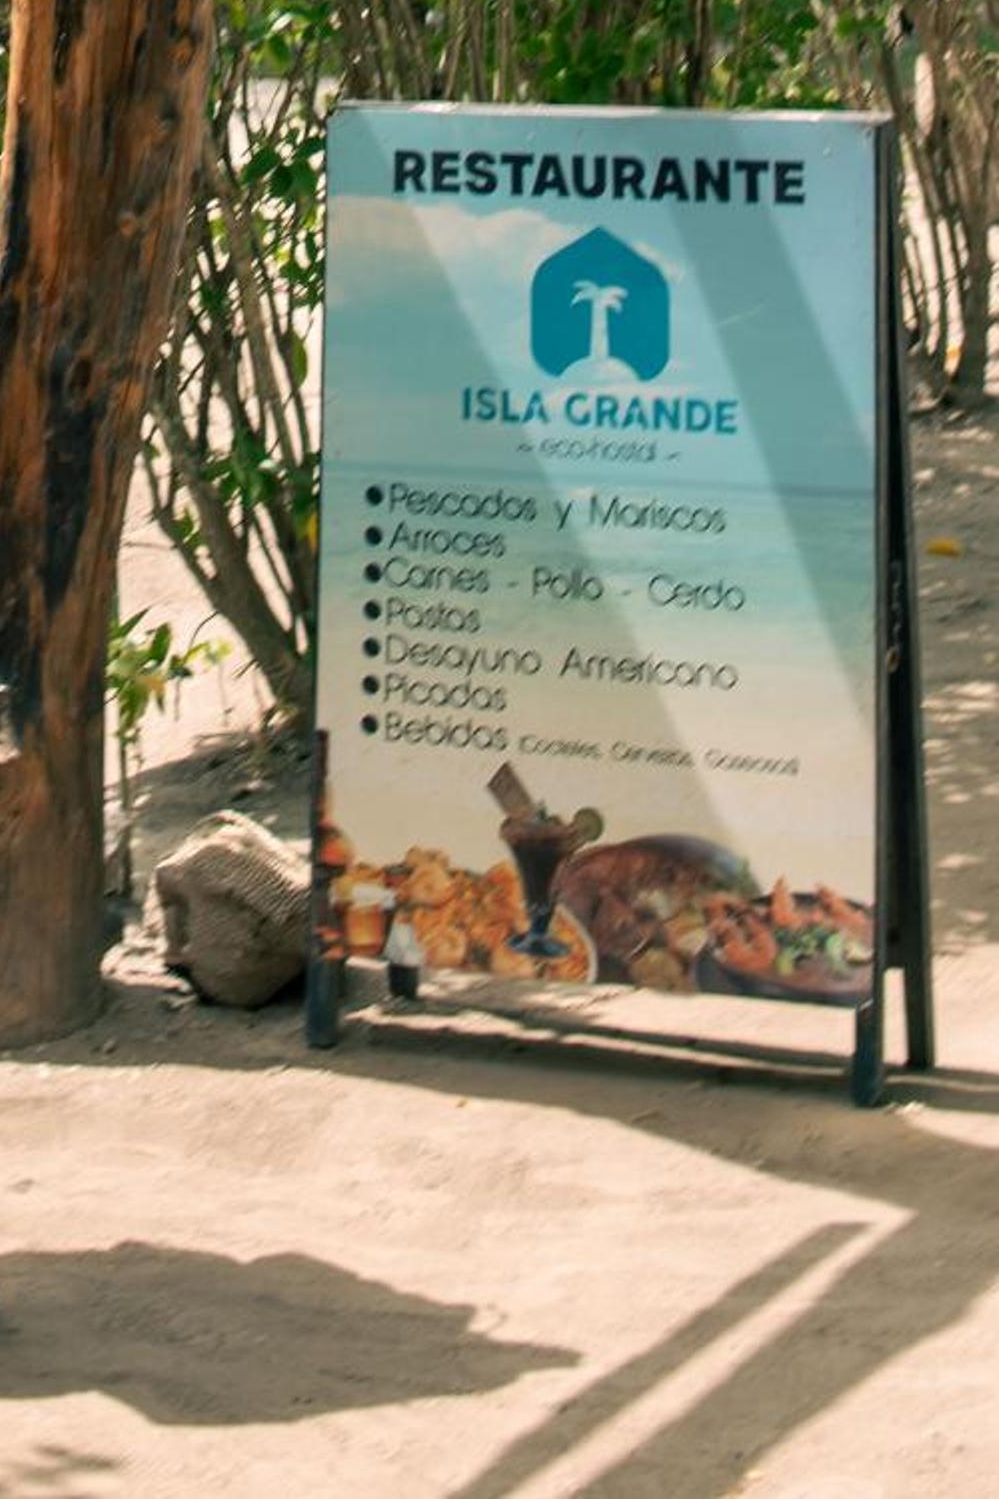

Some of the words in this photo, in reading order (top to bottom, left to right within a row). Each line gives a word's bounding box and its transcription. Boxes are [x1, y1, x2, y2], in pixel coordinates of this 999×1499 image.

[393, 150, 806, 204] RESTAURANTE
[461, 387, 551, 423] ISLA
[564, 392, 739, 435] GRANDE
[387, 482, 537, 523] Pescados
[554, 498, 575, 531] y
[589, 494, 728, 535] Mariscos
[387, 521, 507, 558] Arroces
[383, 556, 491, 594] Carnes
[532, 564, 604, 602] Pollo
[647, 572, 747, 612] Cerdo
[385, 598, 481, 634] Pastas
[385, 633, 542, 676] Desayuno
[559, 646, 739, 691] Americano
[384, 671, 507, 713] Picadas
[384, 709, 508, 752] Bebidas
